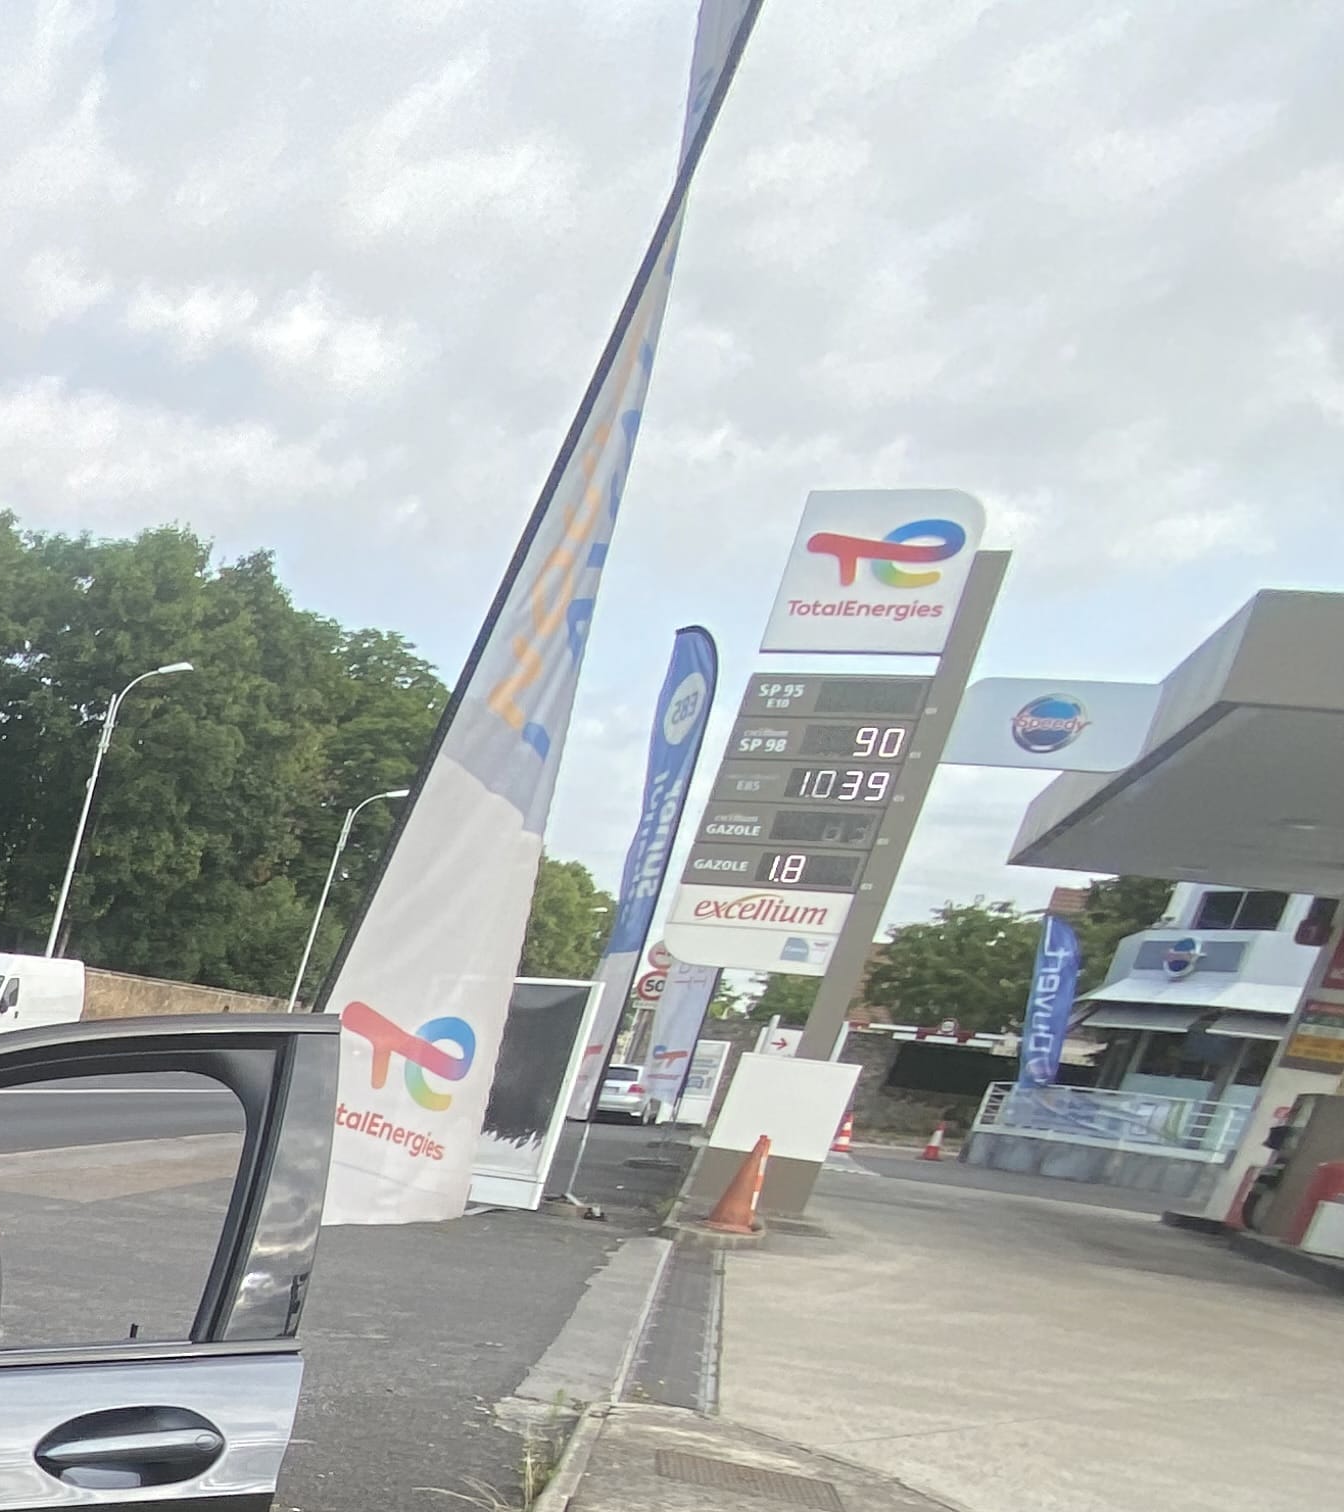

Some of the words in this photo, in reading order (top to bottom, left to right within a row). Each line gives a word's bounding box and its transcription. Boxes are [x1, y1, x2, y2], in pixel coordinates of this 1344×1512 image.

[788, 600, 944, 621] TotalEnergies
[758, 683, 782, 696] SP
[783, 684, 805, 698] 95
[1011, 715, 1093, 734] Speedy
[738, 738, 762, 752] SP
[764, 738, 787, 752] 98
[853, 726, 906, 758] 90
[706, 823, 761, 836] GAZOLE
[693, 859, 749, 871] GAZOLE
[694, 895, 828, 925] excellium
[336, 1103, 445, 1160] talEnergies
